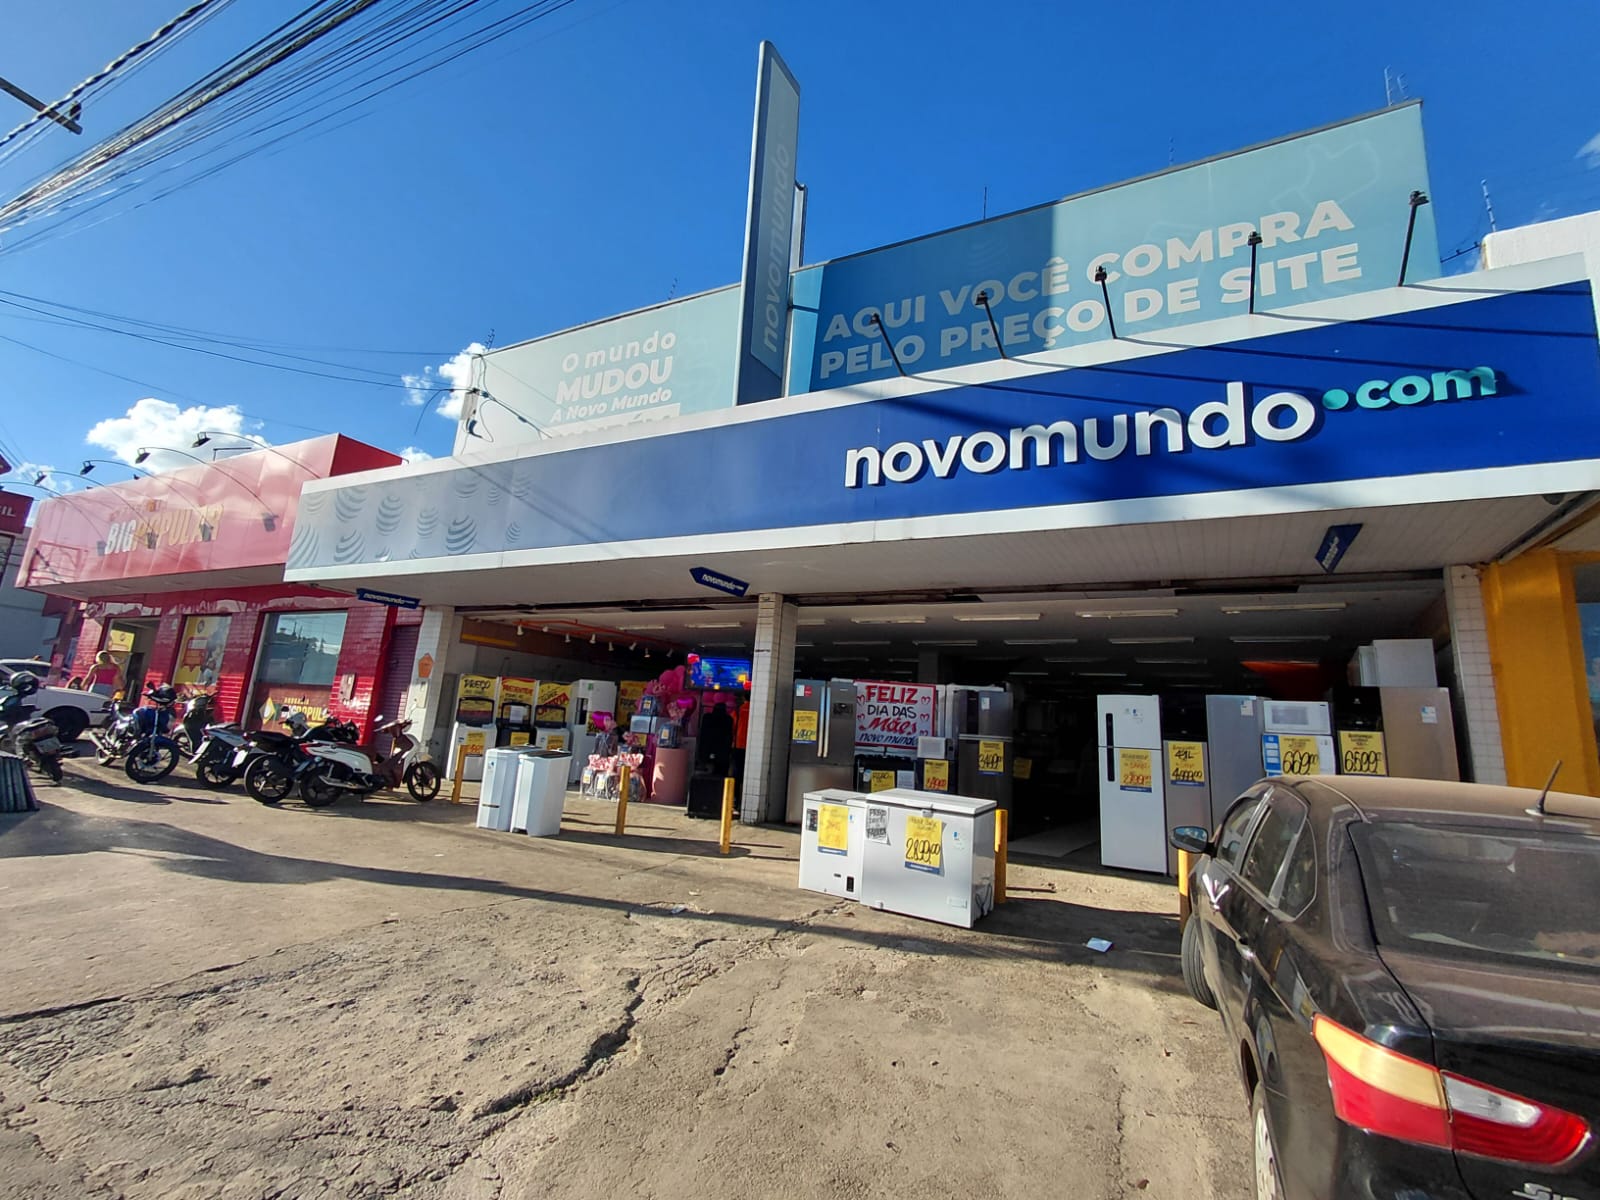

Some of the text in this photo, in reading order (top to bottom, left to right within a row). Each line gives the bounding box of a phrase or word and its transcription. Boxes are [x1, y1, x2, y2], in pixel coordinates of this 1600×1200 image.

[823, 200, 1354, 342] AQUI VOCÊ COMPRA
[820, 243, 1362, 379] PELO PREÇO DE SITE
[562, 330, 676, 373] O mundo
[556, 356, 673, 405] MUDOU
[551, 409, 562, 423] A
[566, 402, 607, 420] Novo
[611, 387, 672, 411] Mundo
[865, 685, 918, 704] FELIZ
[867, 705, 917, 719] DIA DAS
